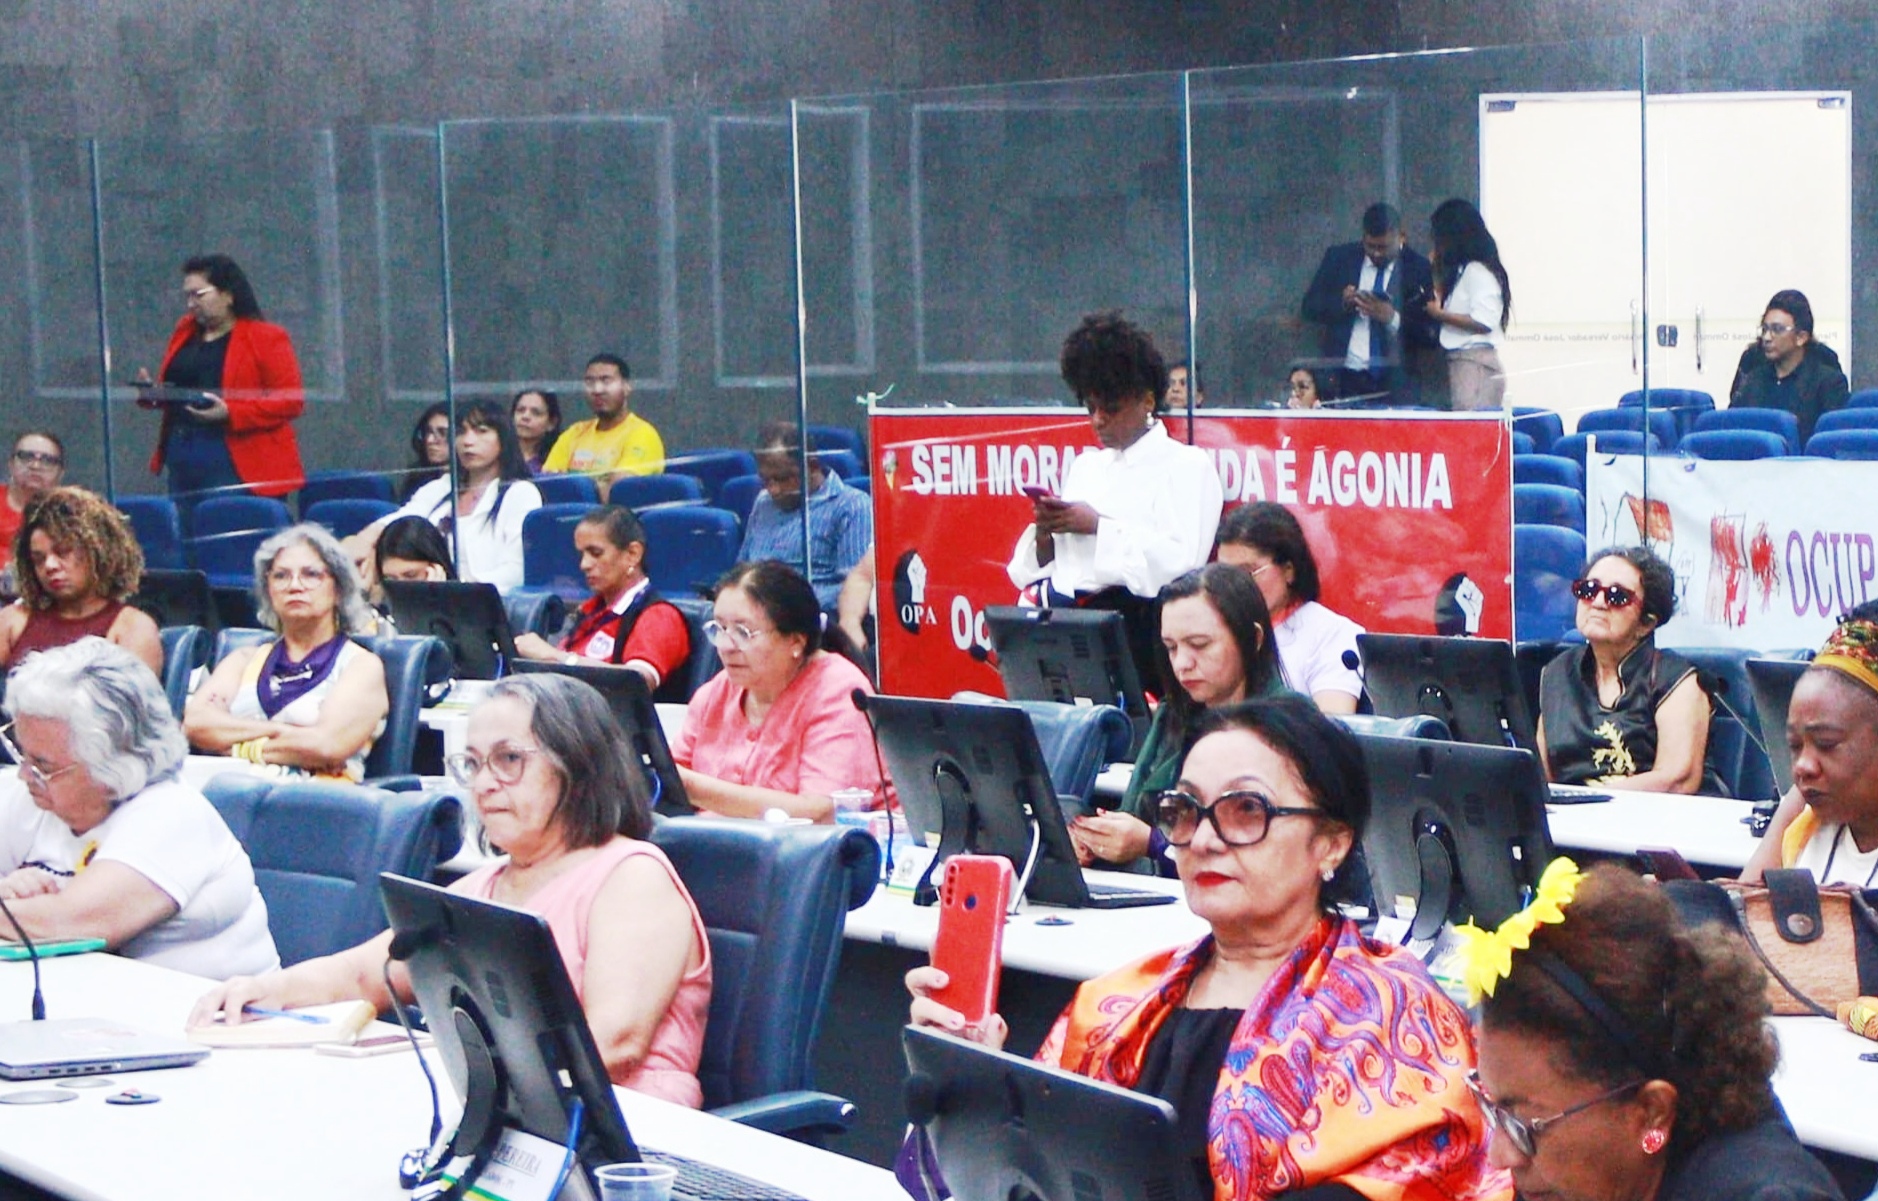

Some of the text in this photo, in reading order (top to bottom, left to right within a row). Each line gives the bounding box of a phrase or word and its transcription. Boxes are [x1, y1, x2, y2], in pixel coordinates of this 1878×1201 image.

[912, 444, 977, 496] SEM
[1274, 435, 1298, 504] É
[1307, 445, 1453, 510] AGONIA
[900, 603, 938, 626] OPA
